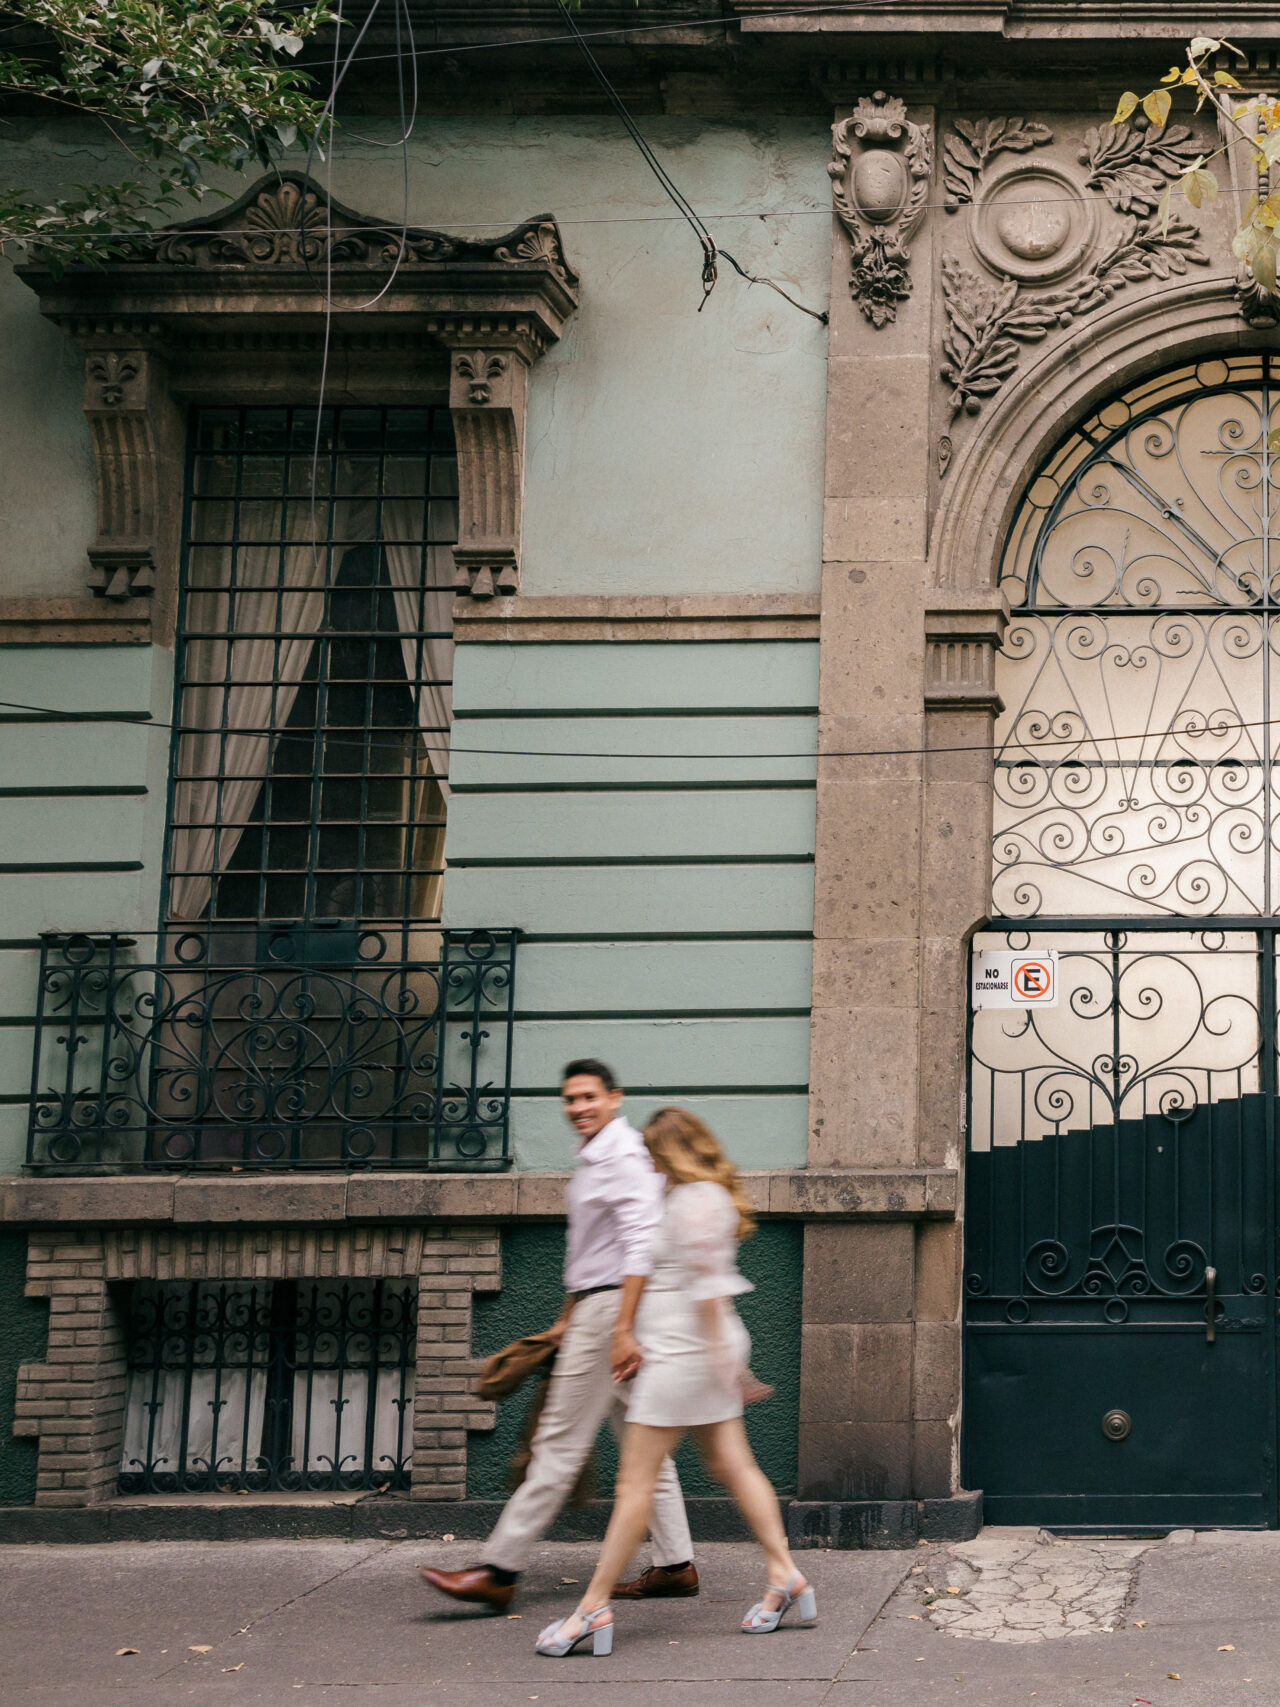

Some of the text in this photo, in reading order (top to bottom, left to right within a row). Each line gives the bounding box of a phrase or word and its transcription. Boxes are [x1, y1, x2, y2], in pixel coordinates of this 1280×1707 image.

[985, 969, 999, 978] NO
[1024, 969, 1041, 991] E
[976, 982, 1008, 990] ESTACIONARSE
